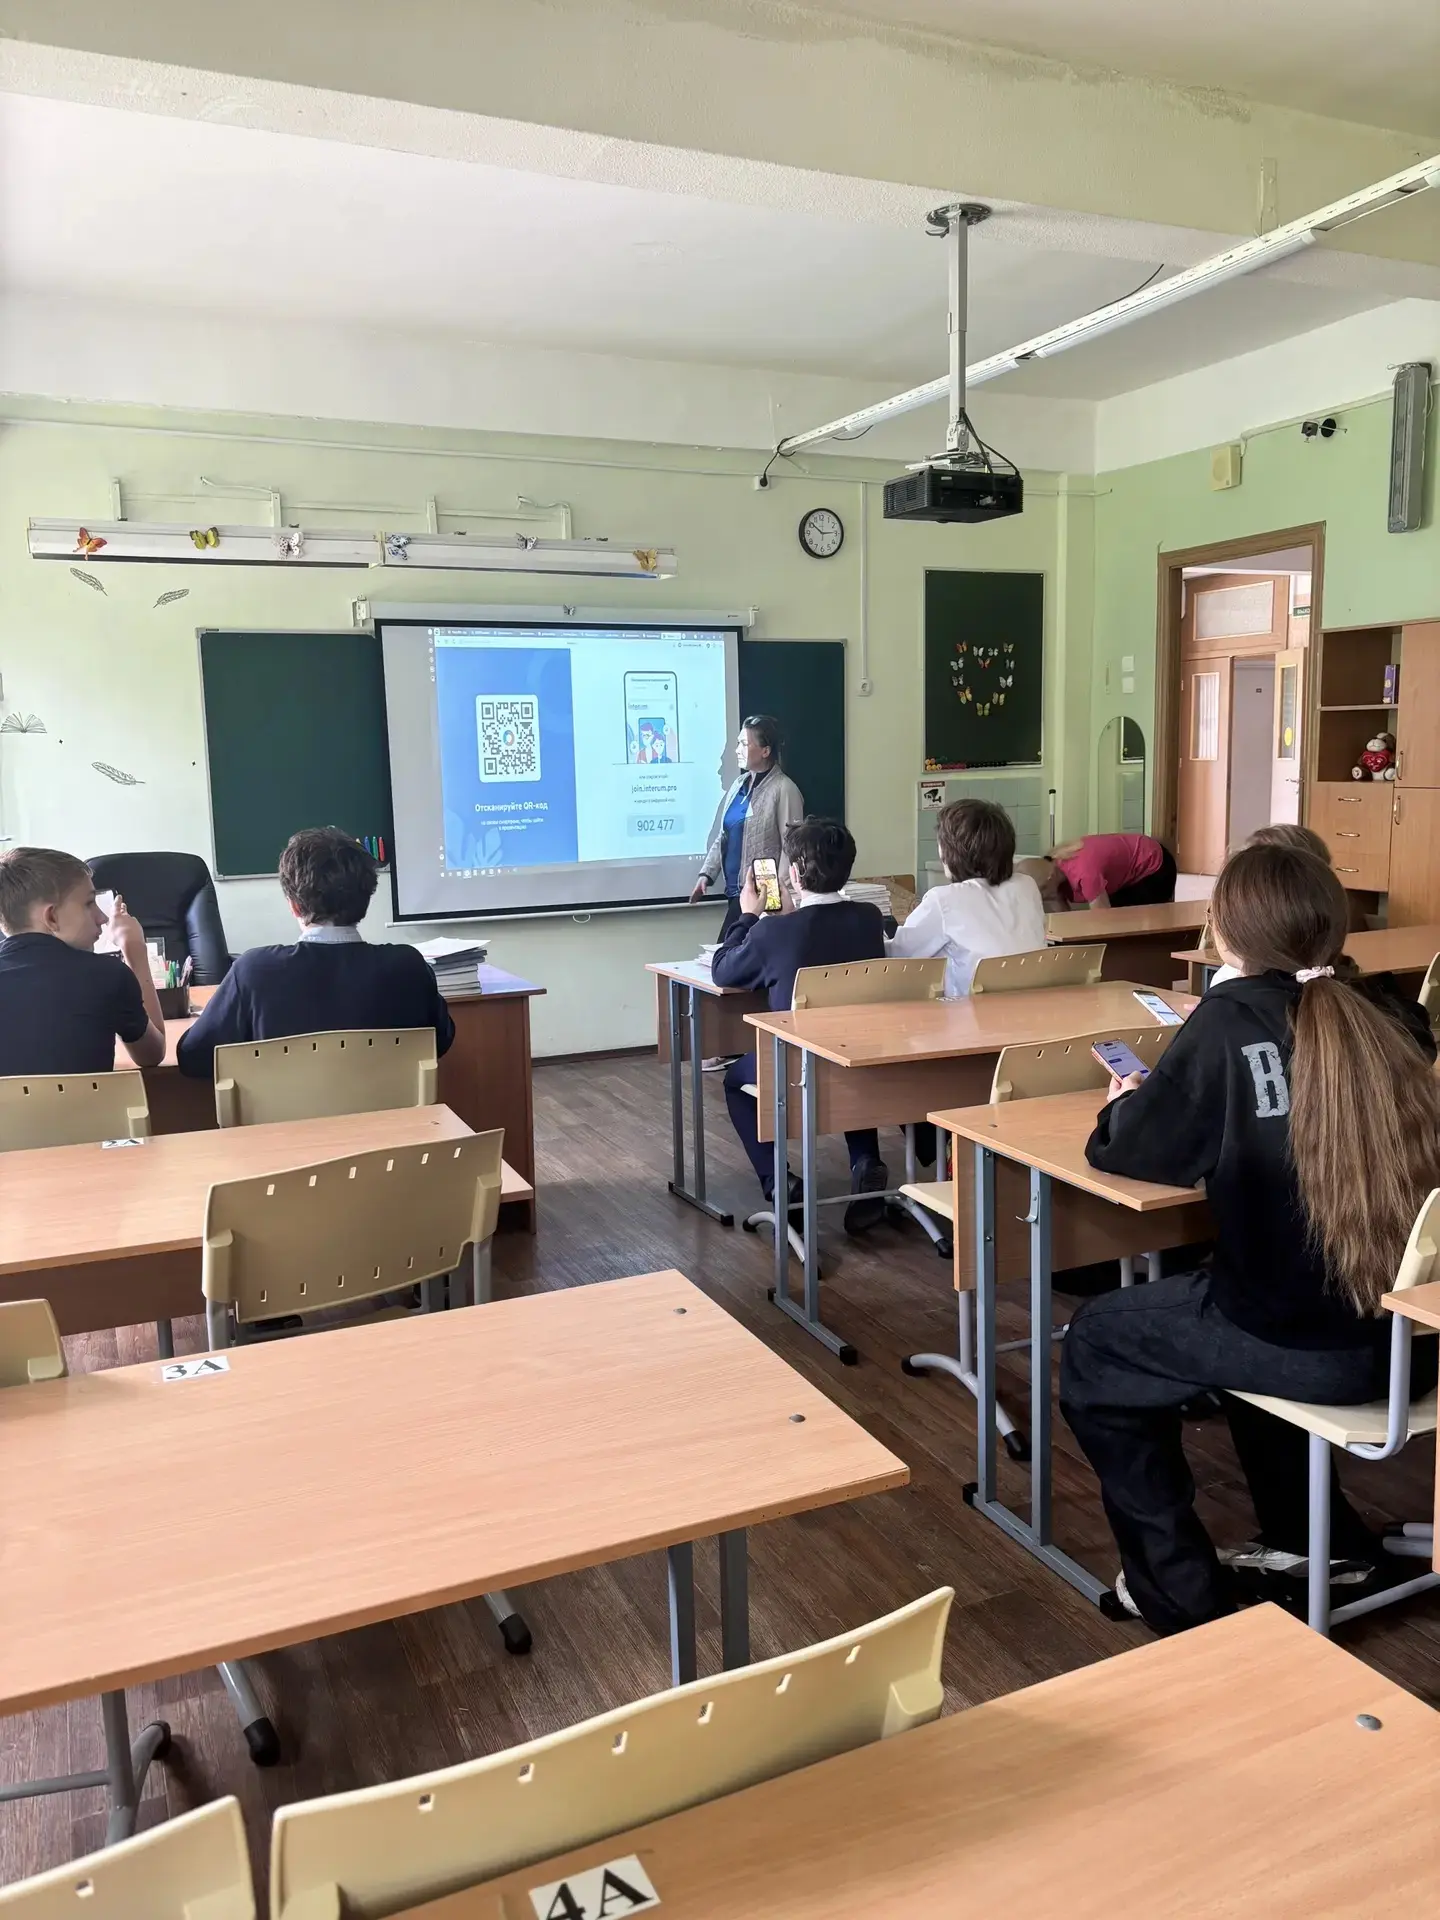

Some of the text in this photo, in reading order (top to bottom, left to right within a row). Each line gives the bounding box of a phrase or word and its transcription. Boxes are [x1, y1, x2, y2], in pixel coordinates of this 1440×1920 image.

[631, 785, 677, 794] join.interum.pro
[475, 801, 548, 812] Отсканируйте QR-код
[637, 819, 674, 831] 902 477
[1241, 1042, 1290, 1118] B
